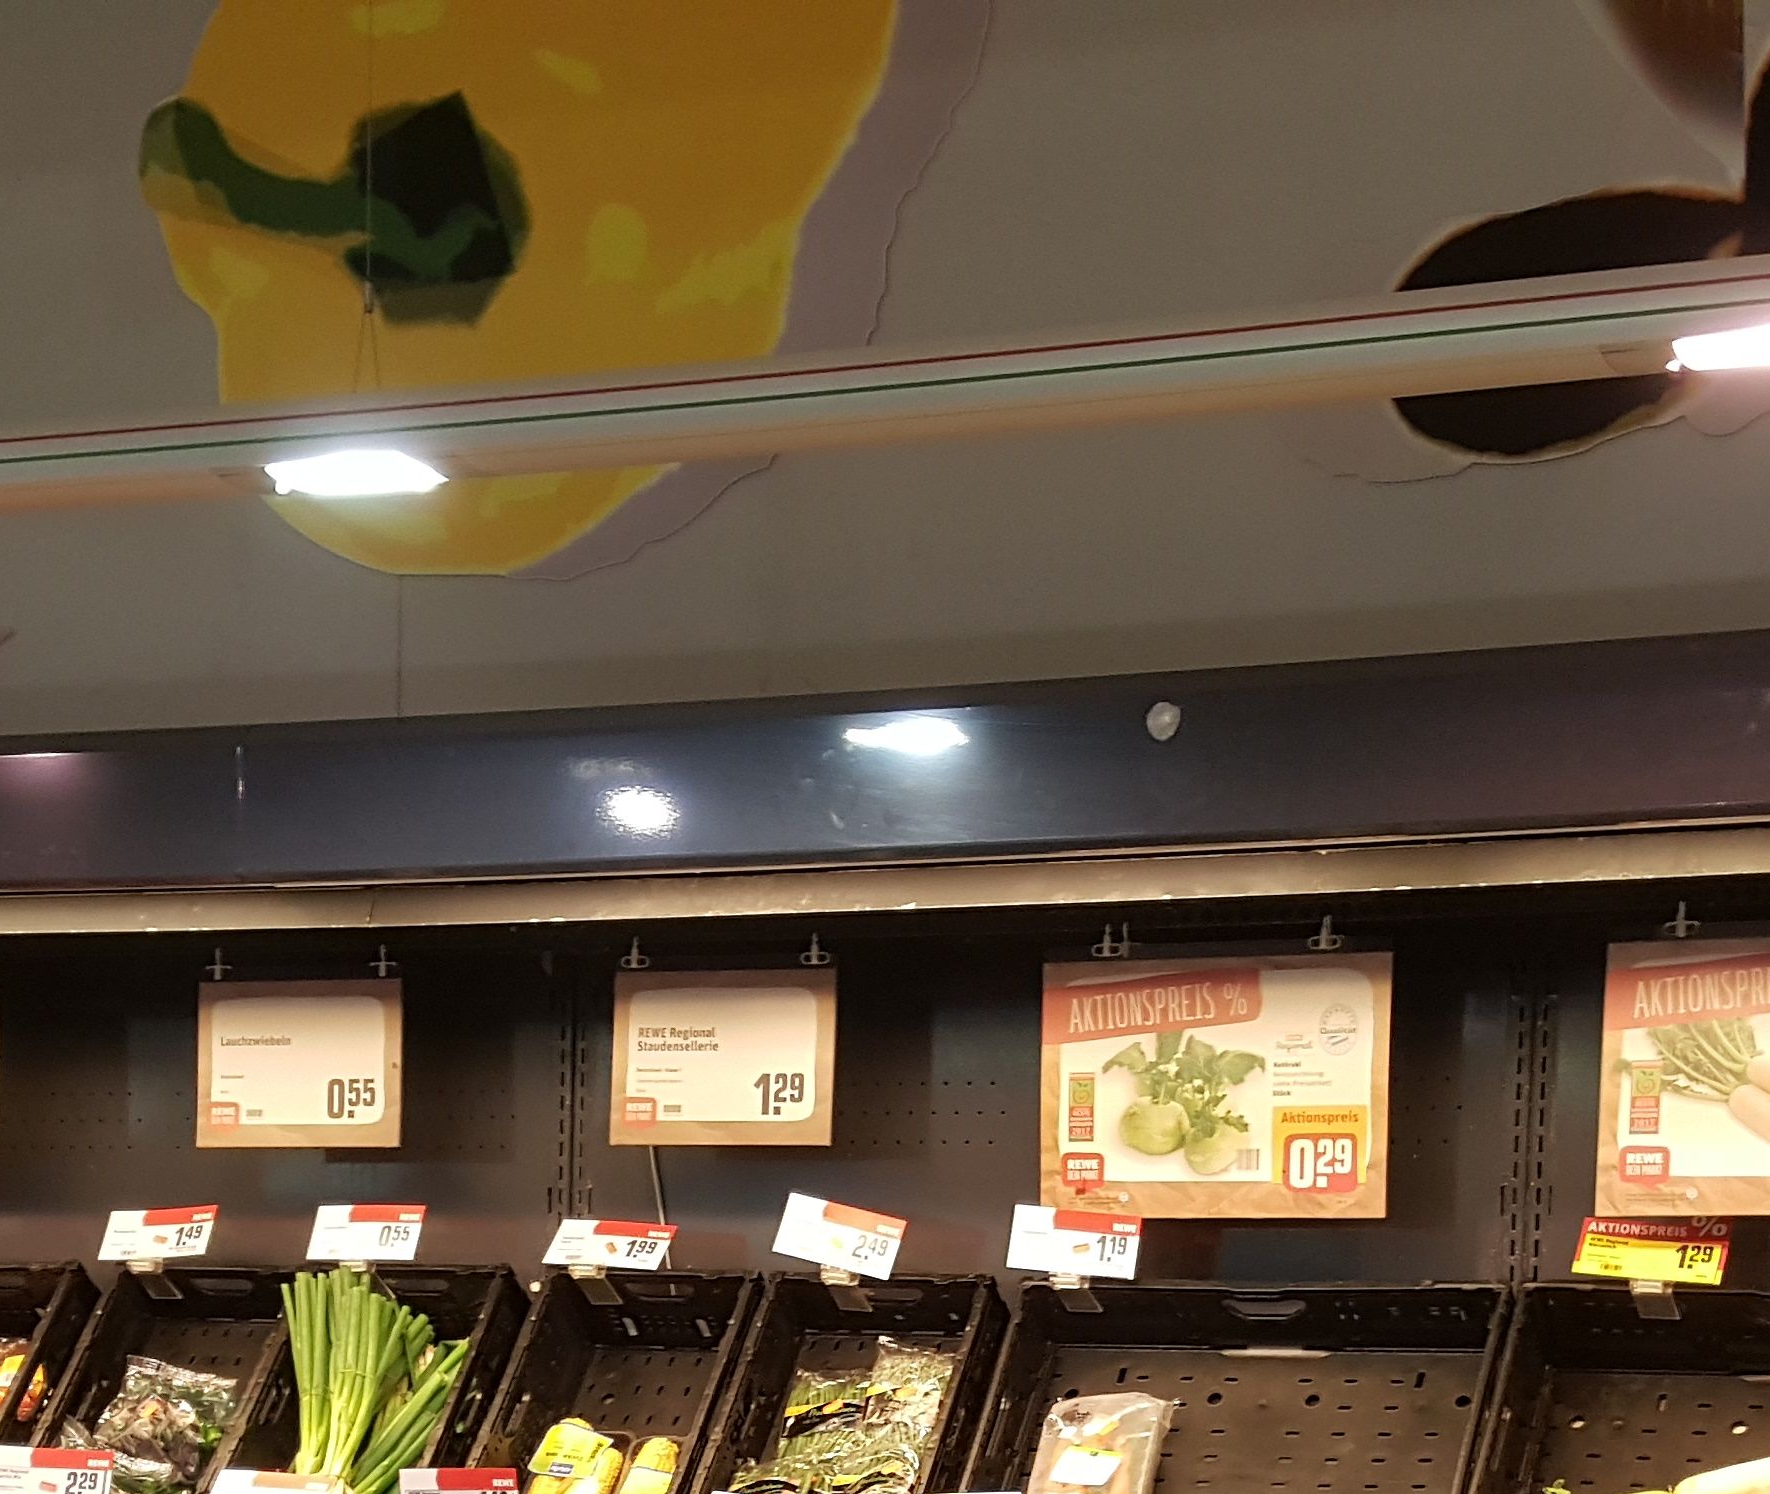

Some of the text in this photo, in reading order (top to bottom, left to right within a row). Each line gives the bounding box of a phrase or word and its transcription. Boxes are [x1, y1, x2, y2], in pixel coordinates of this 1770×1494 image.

[1069, 982, 1247, 1033] AKTIONSPREIS %
[220, 1035, 291, 1047] Lauchzwiebeln
[638, 1027, 716, 1042] REWE Regional
[637, 1040, 719, 1053] Staudensellerie
[327, 1079, 376, 1118] 0.55
[753, 1073, 805, 1115] 1.29
[1280, 1112, 1359, 1125] Aktionspreis
[1067, 1159, 1100, 1170] REWE
[1289, 1138, 1353, 1189] 0.29
[1626, 1152, 1664, 1164] REWE
[175, 1225, 203, 1246] 1.49
[379, 1225, 410, 1248] 0.55
[1587, 1221, 1688, 1237] AKTIONSPREIS
[626, 1239, 658, 1258] 1.99
[853, 1235, 889, 1261] 2.49
[1096, 1235, 1128, 1262] 1.19
[1675, 1244, 1715, 1269] 1.29
